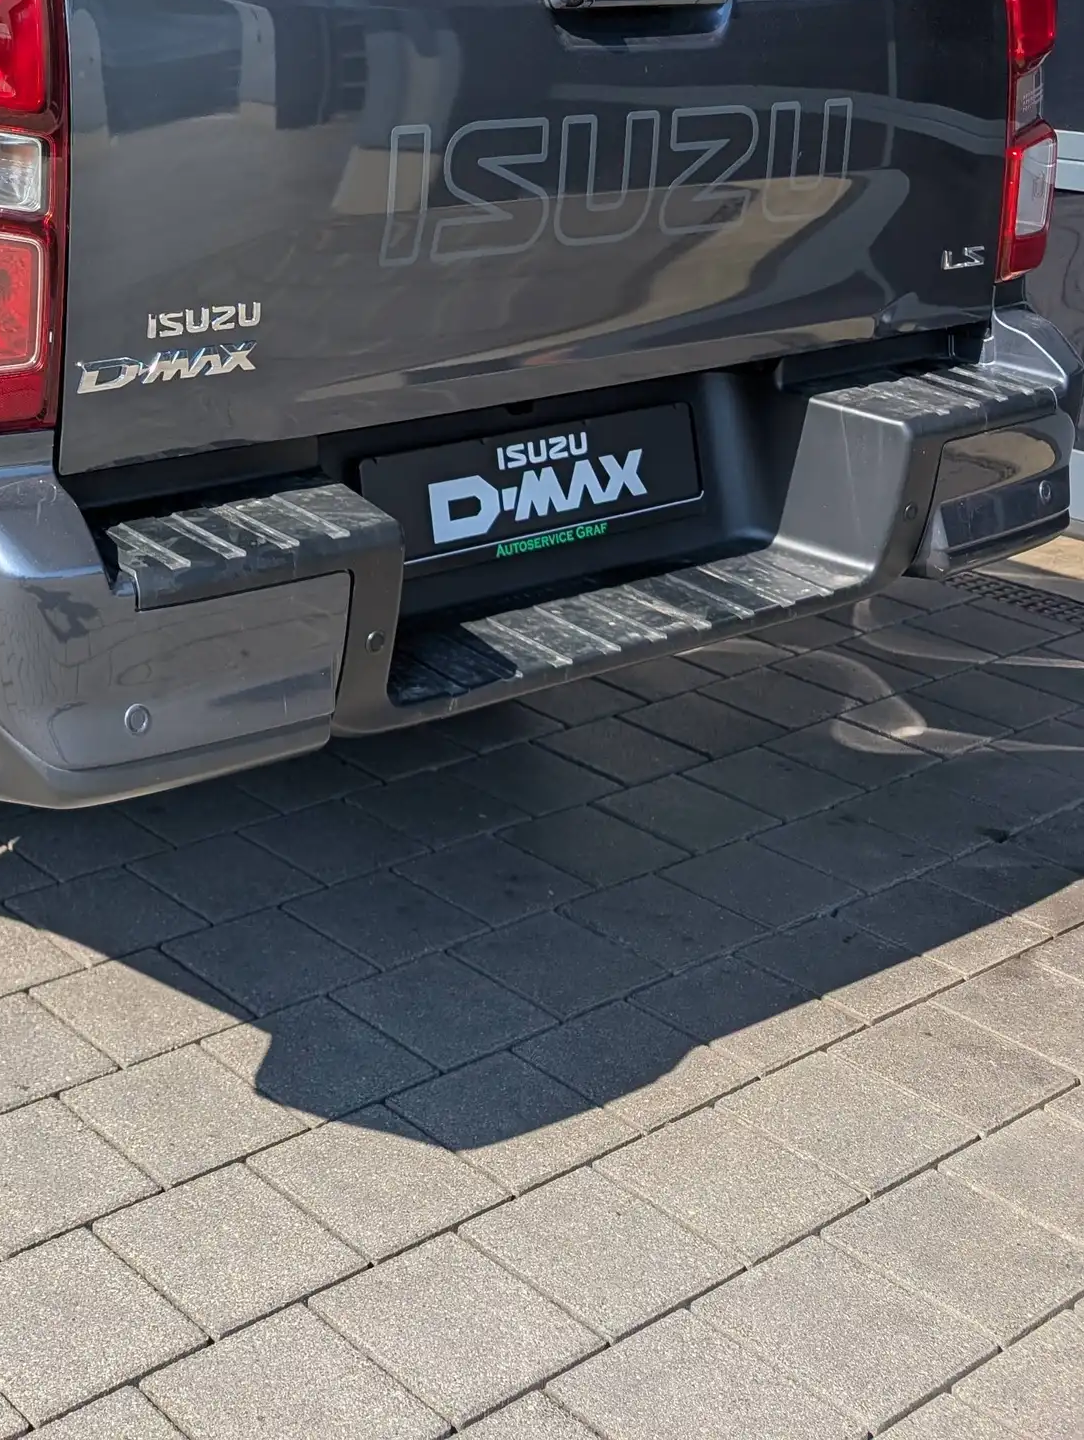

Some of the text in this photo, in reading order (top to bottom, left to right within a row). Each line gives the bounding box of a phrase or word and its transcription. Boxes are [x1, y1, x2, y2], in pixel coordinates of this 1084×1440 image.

[379, 97, 853, 266] ISUZU
[941, 245, 984, 270] LS
[147, 302, 261, 339] ISUZU
[75, 340, 257, 394] D-MAX
[496, 432, 588, 470] ISUZU
[428, 449, 647, 544] D-MAX
